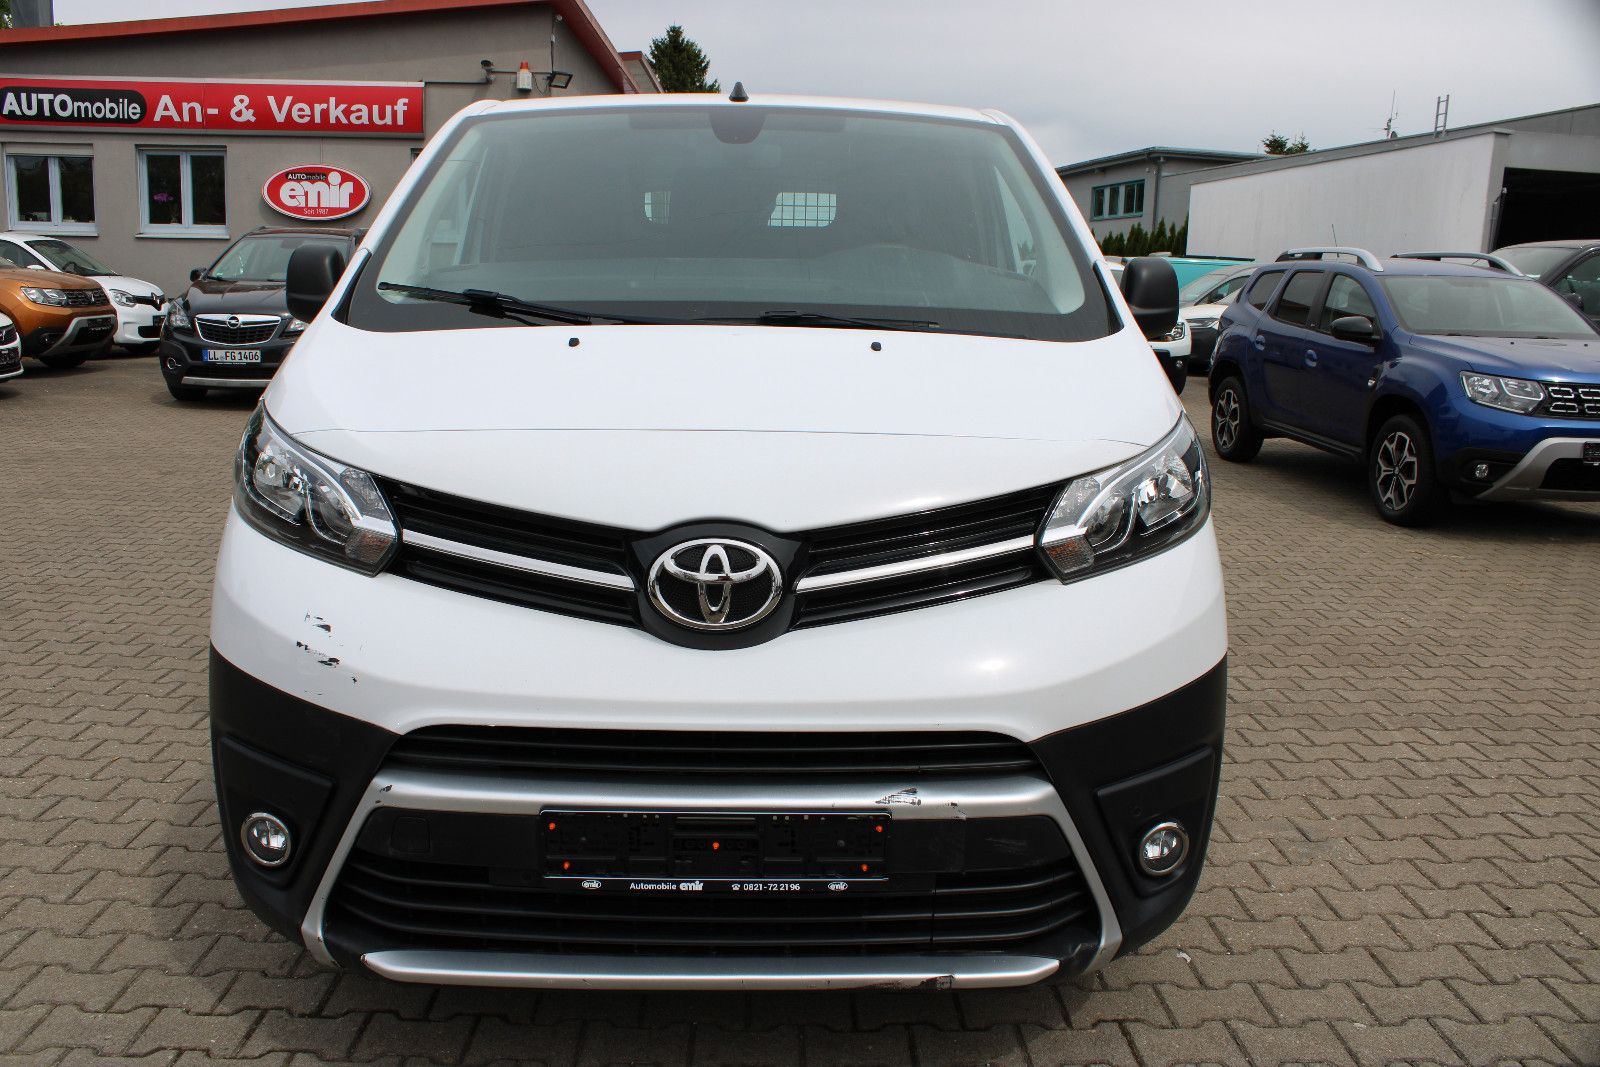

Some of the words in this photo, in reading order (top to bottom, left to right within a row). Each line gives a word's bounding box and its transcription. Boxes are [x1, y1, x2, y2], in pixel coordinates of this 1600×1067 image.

[2, 92, 142, 120] AUTOmobile
[153, 94, 219, 123] An-
[229, 94, 257, 123] &
[267, 95, 409, 126] Verkauf
[287, 173, 326, 181] AUTOmobile
[280, 171, 354, 208] emir
[208, 351, 219, 361] LL
[225, 351, 236, 361] FG
[238, 351, 259, 361] 1406
[629, 882, 677, 890] Automobile
[679, 880, 704, 891] emir
